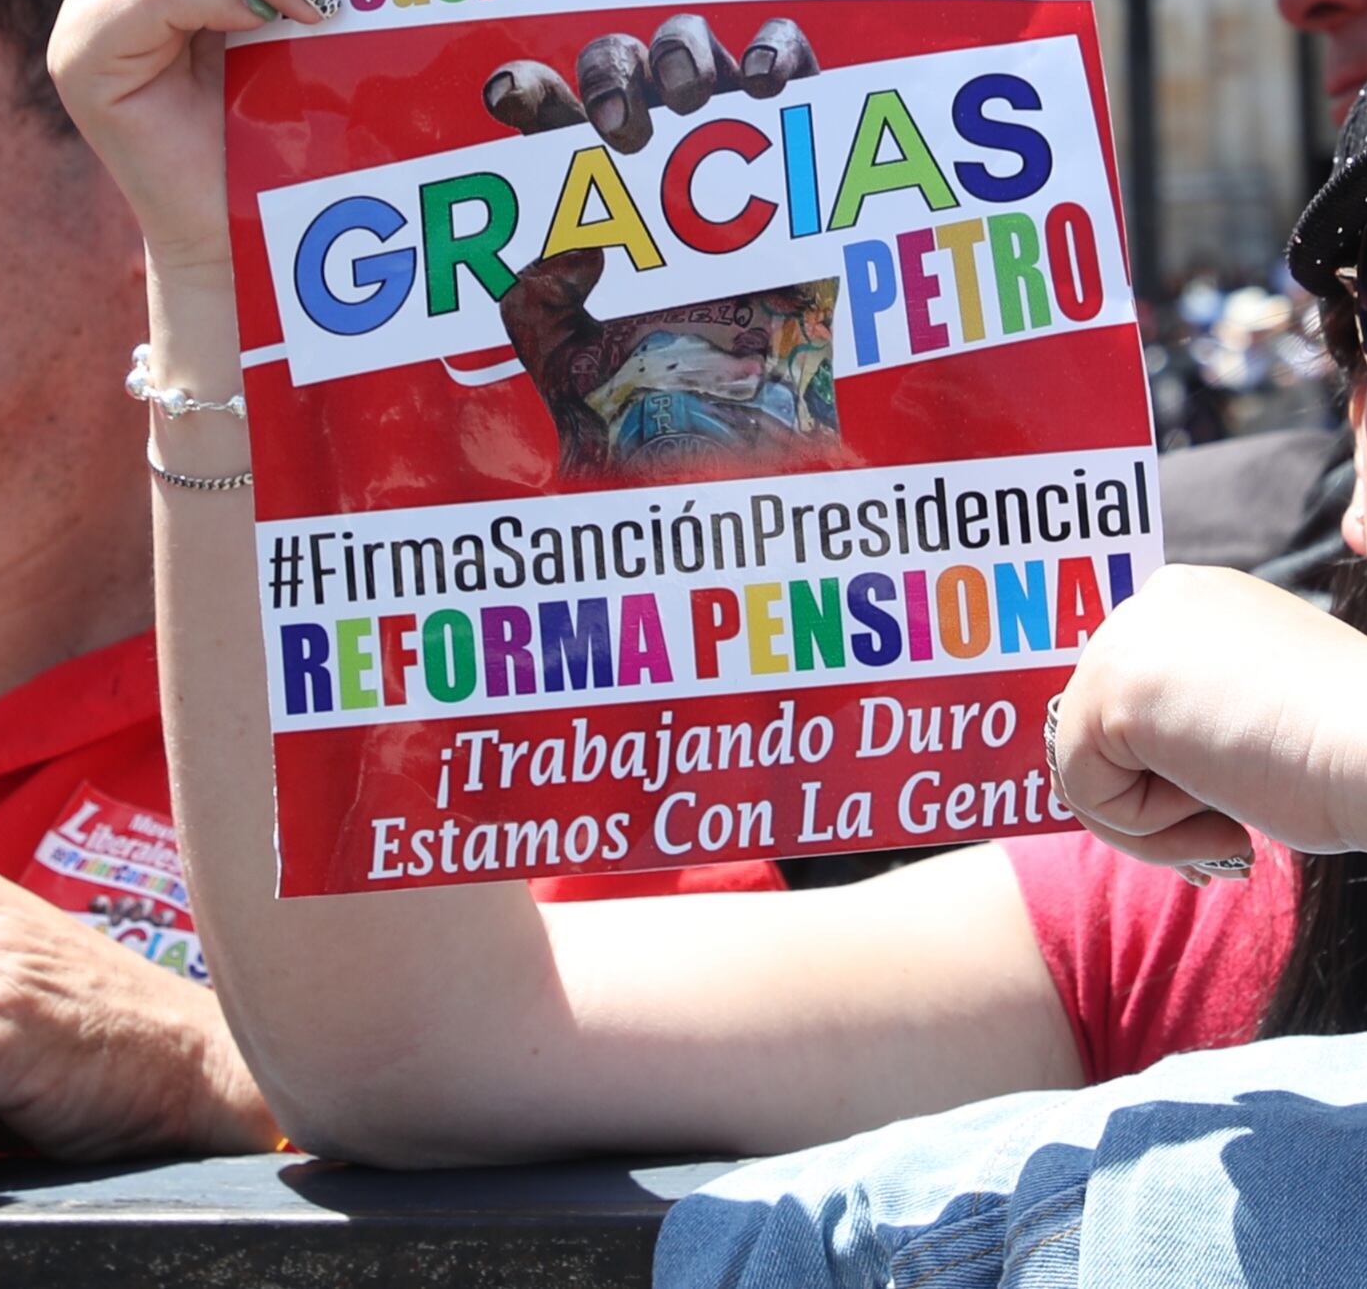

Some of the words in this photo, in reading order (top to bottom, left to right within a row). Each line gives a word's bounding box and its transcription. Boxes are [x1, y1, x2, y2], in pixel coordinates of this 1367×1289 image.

[293, 73, 1054, 336] GRACIAS
[843, 202, 1105, 367] PETRO
[268, 462, 1151, 609] #FirmaSanciónPresidencial
[281, 593, 674, 715] REFORMA
[436, 713, 833, 809] ¡Trabajando
[857, 697, 1017, 760] Duro
[368, 812, 630, 880] Estamos
[653, 790, 774, 855] Con
[797, 781, 872, 843] La
